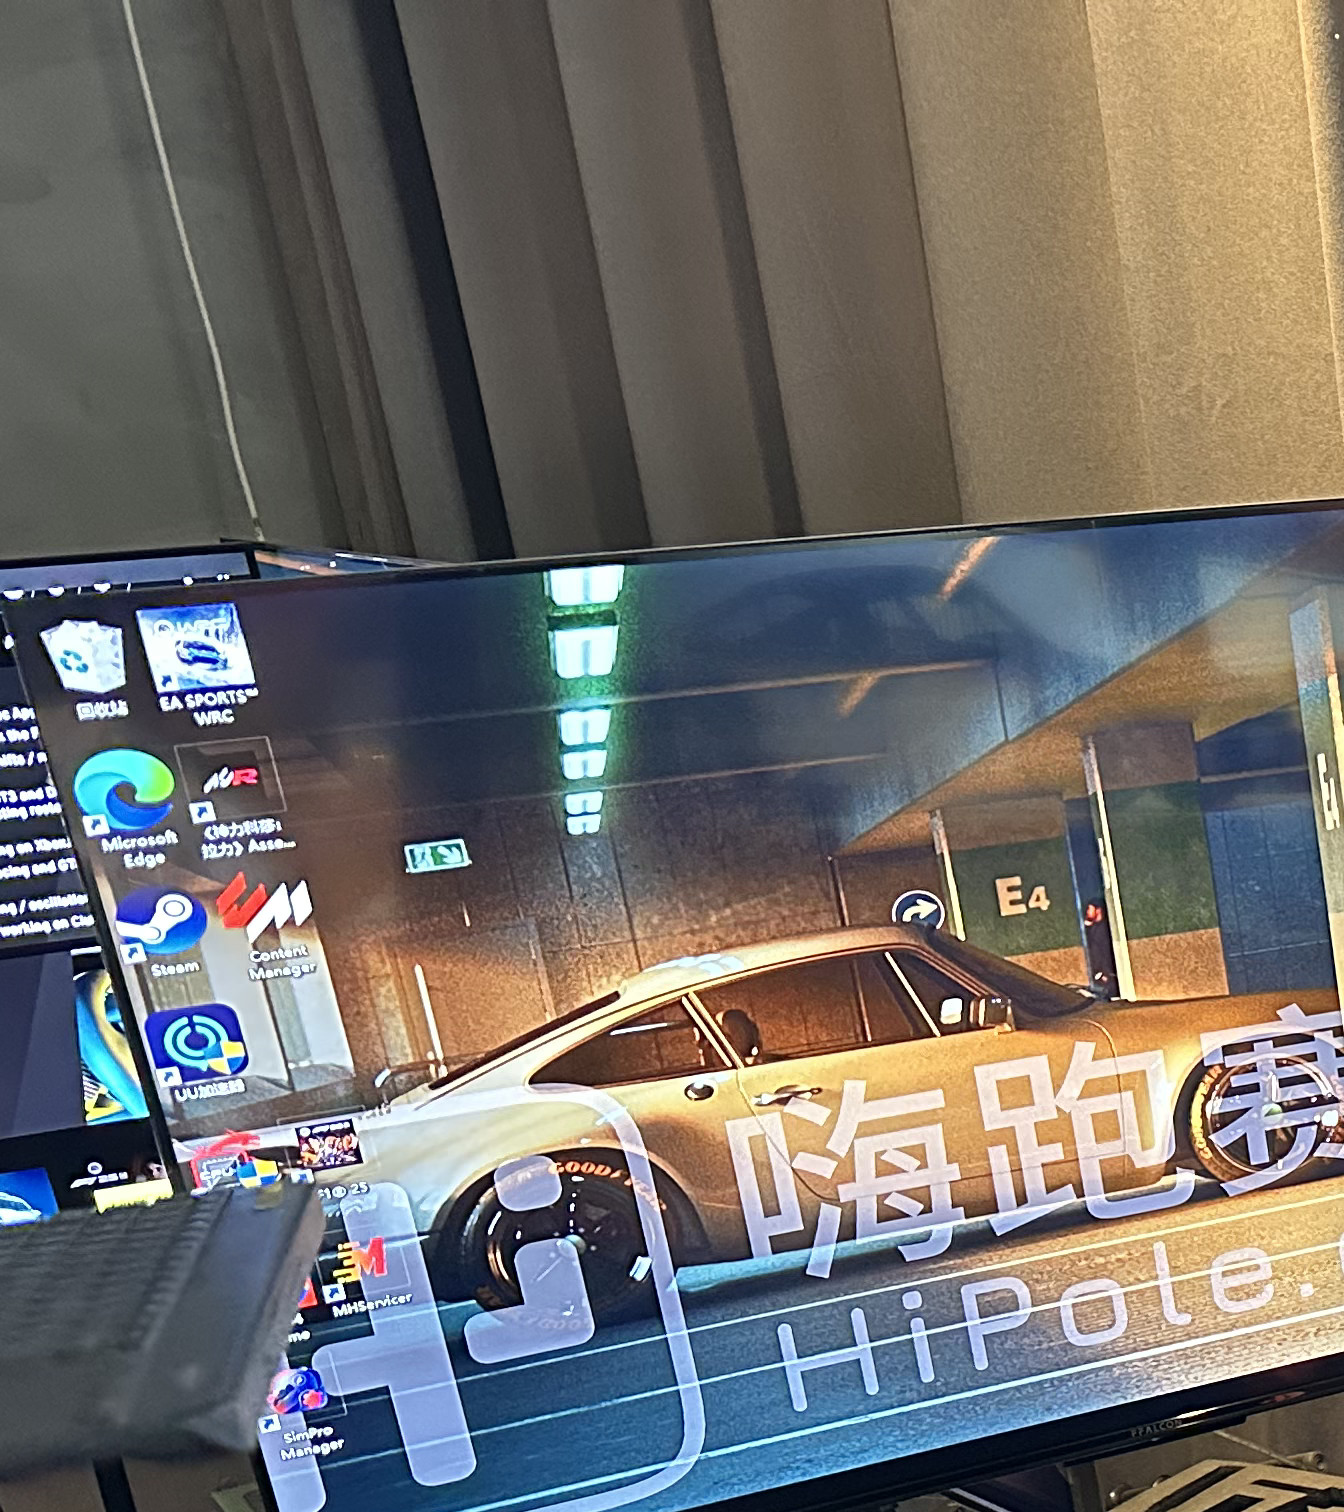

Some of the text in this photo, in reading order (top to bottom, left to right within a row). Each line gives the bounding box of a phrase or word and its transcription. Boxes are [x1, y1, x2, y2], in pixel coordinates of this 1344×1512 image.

[159, 696, 184, 712] EA
[193, 710, 235, 727] WRC
[102, 829, 178, 852] Microsoft
[124, 852, 166, 869] Edge
[995, 876, 1051, 917] E4
[249, 944, 309, 963] Content
[151, 960, 200, 978] Steam
[249, 962, 317, 982] Manager
[283, 1426, 334, 1445] SimPro
[279, 1437, 345, 1461] Manager
